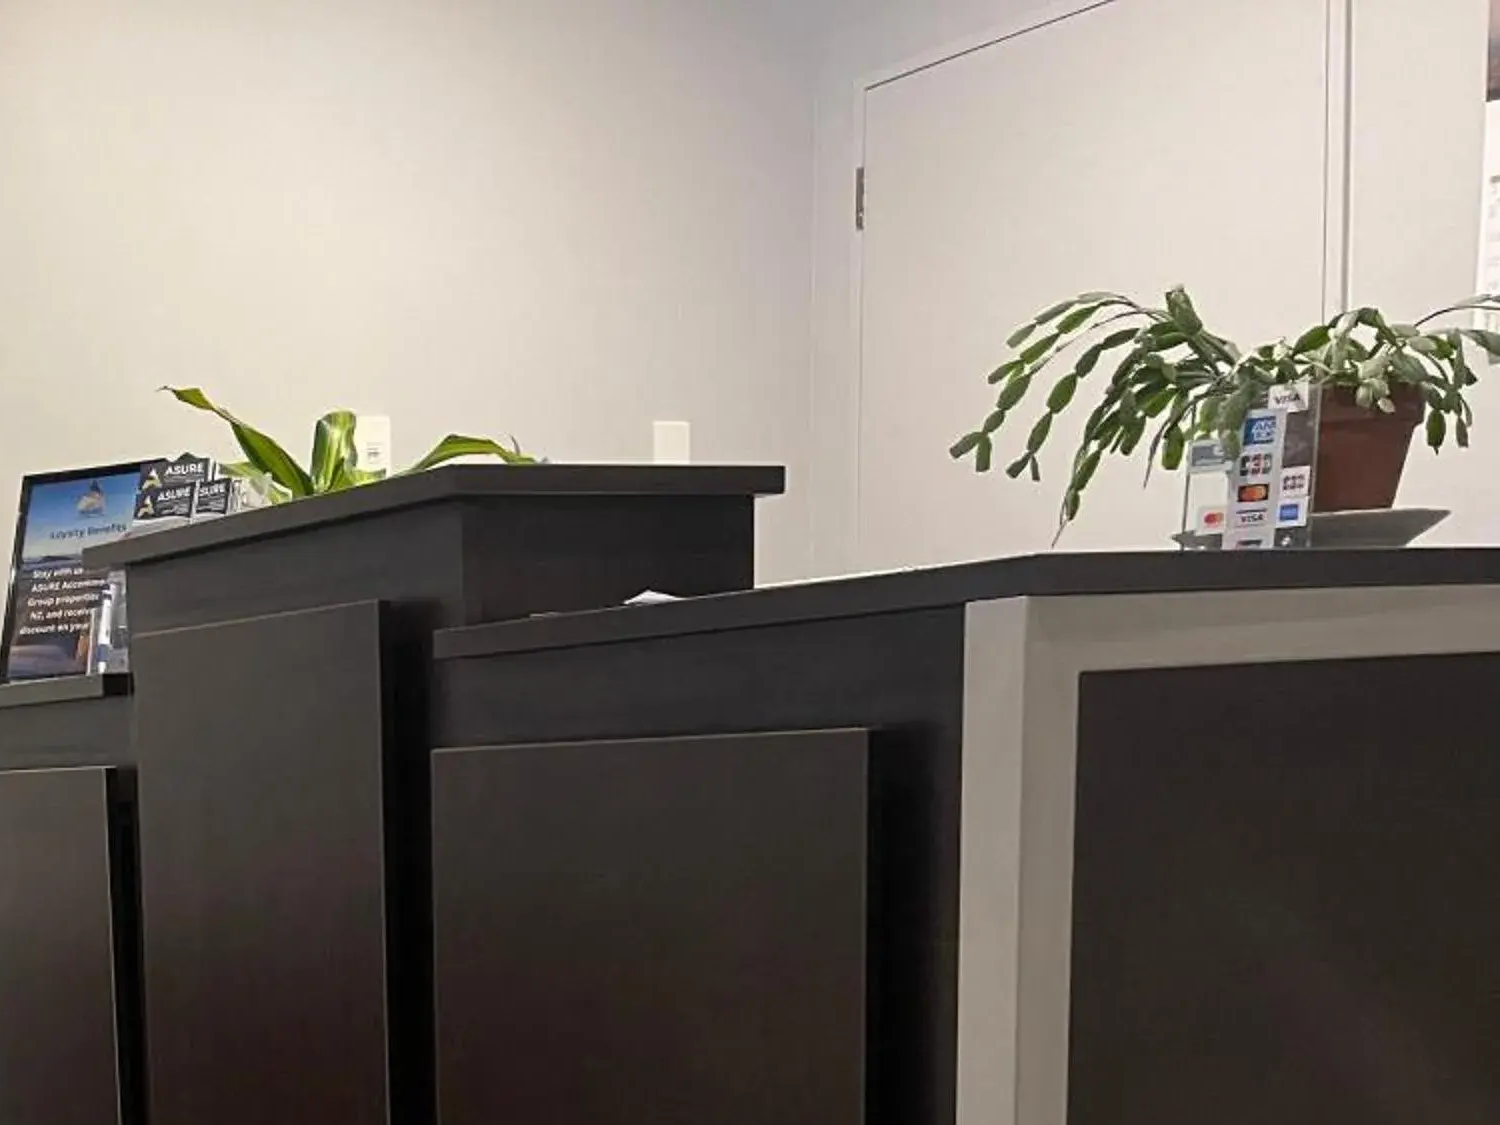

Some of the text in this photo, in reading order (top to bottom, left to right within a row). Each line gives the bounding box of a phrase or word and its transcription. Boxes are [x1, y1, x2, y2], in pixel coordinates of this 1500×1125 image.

[1274, 393, 1301, 405] VISA
[165, 463, 205, 475] ASURE
[157, 485, 192, 501] ASURE
[200, 482, 225, 497] SURE
[1240, 513, 1264, 524] VISA
[31, 582, 60, 593] ASURE
[27, 598, 56, 607] Group
